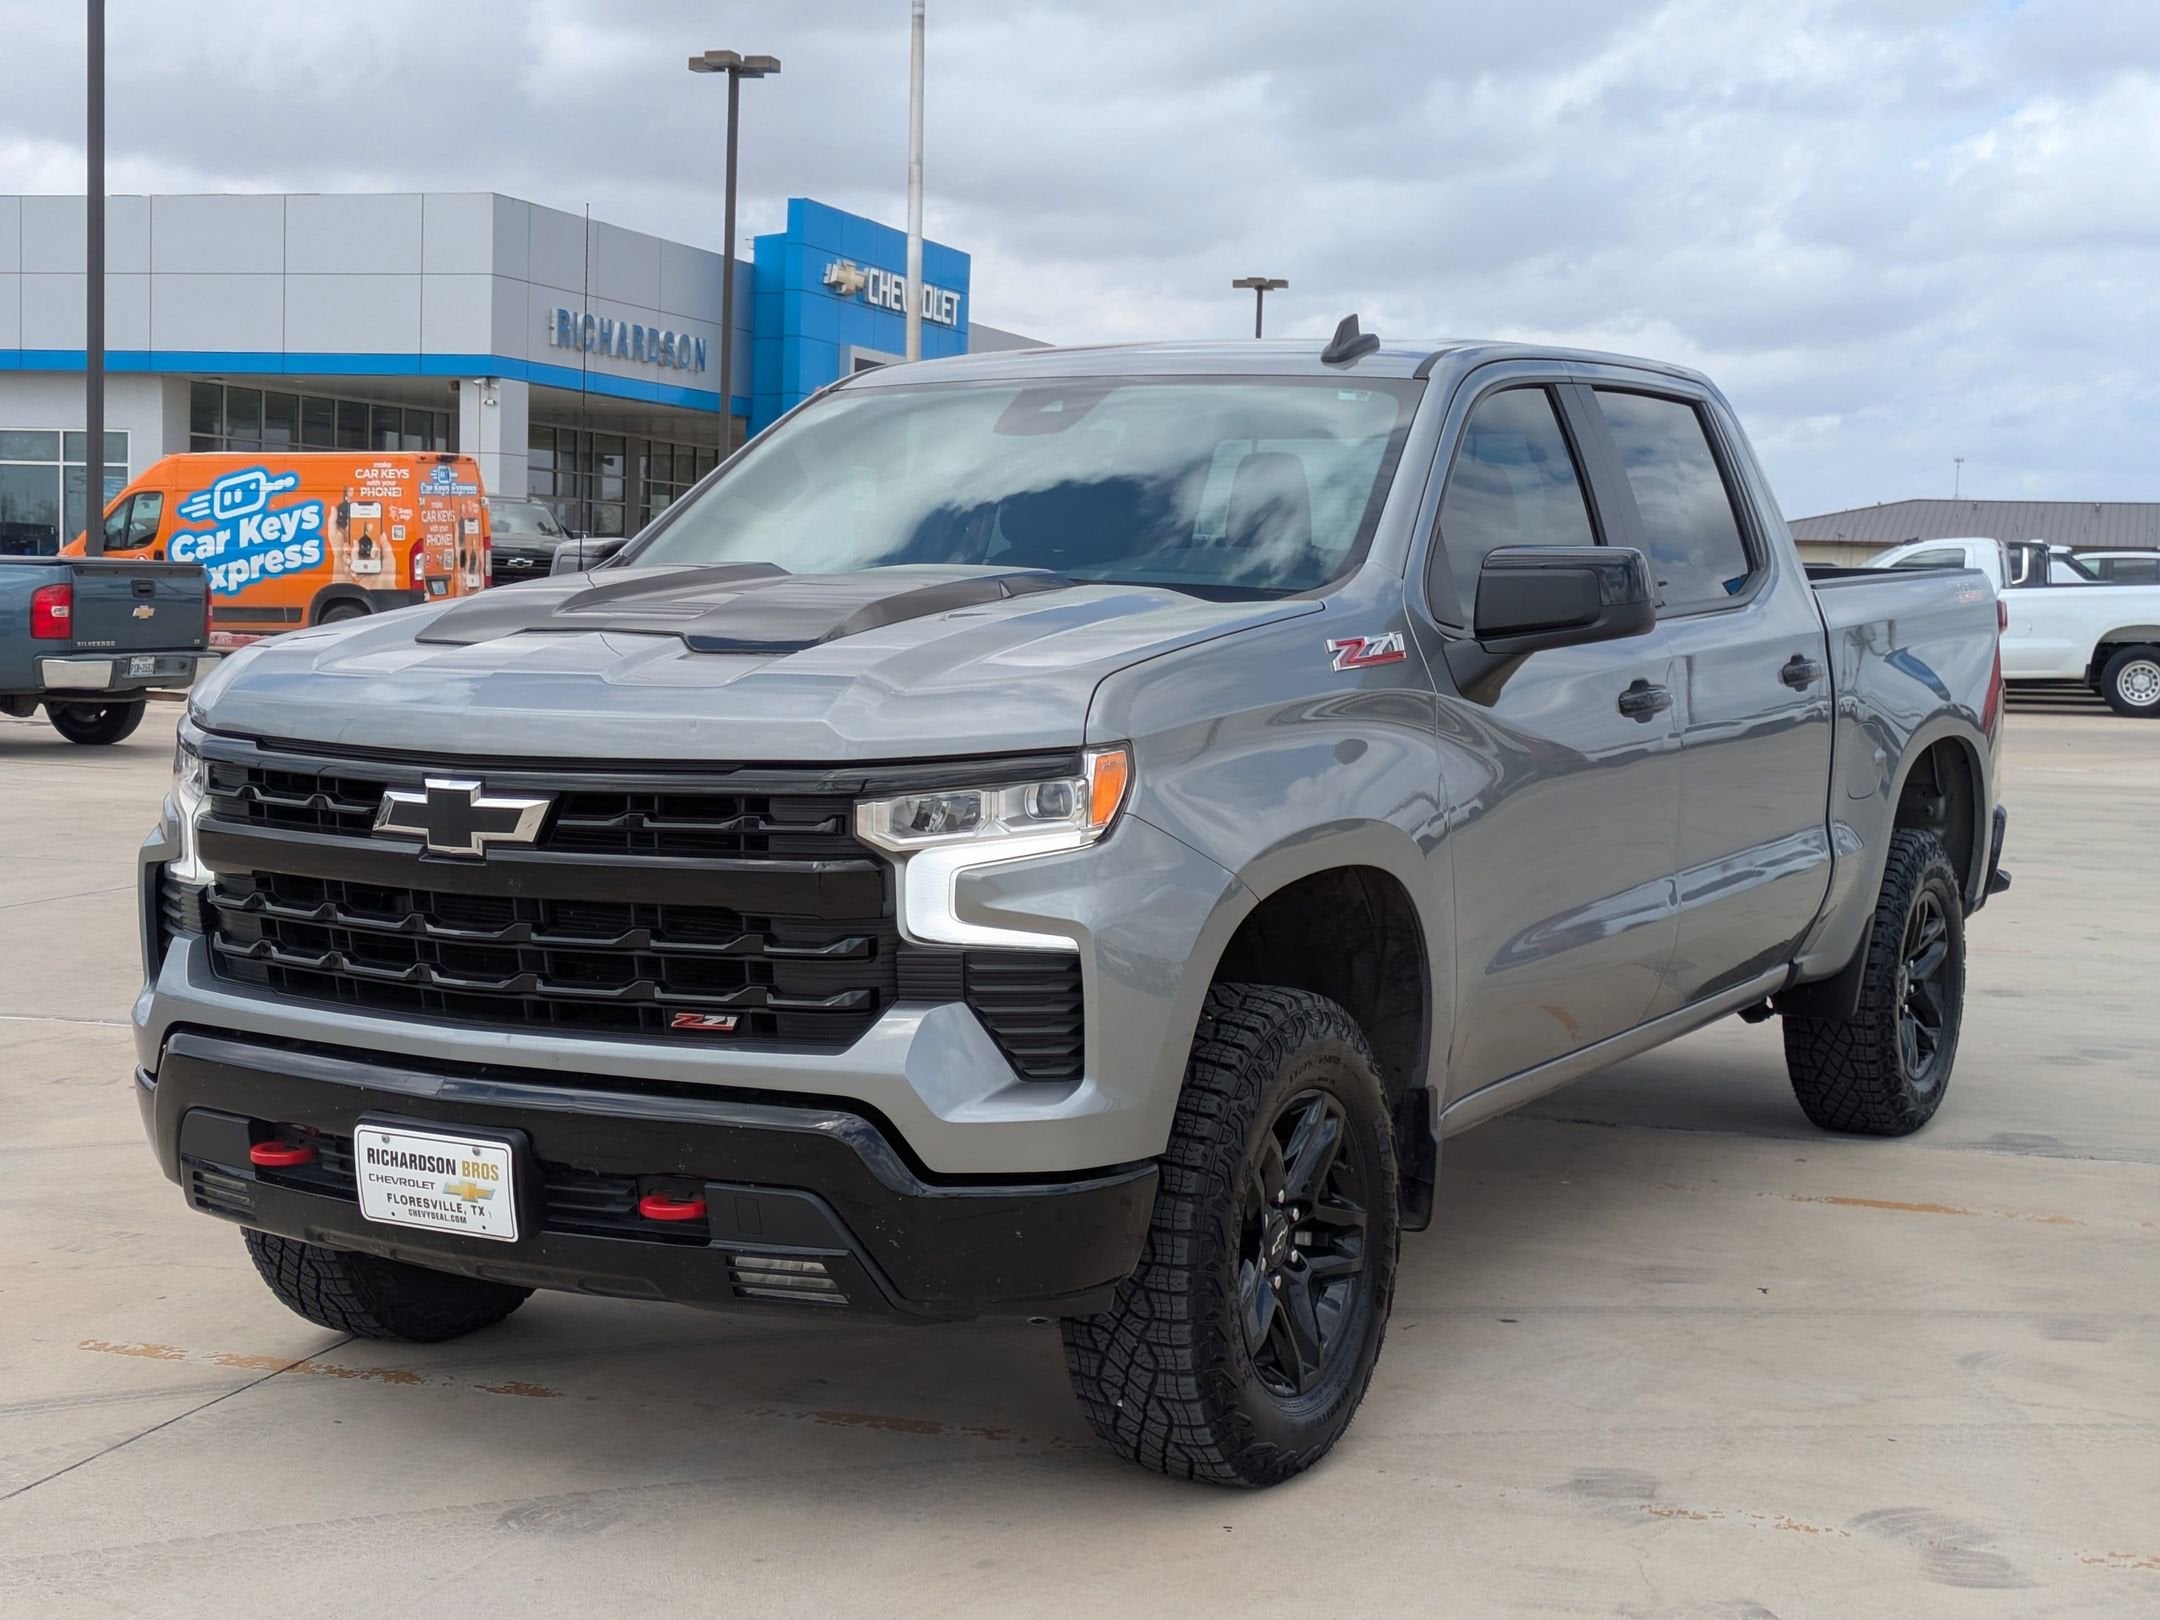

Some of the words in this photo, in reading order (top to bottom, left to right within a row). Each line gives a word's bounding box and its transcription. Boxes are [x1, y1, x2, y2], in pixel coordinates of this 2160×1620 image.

[866, 266, 960, 326] CHEVOLET
[551, 308, 706, 372] RICHARDSON
[355, 469, 379, 479] CAR
[381, 468, 410, 479] KEYS
[360, 487, 402, 497] PHONE!
[421, 510, 437, 522] CAR
[437, 510, 455, 521] KEYS
[171, 529, 231, 562] Car
[239, 504, 320, 548] Keys
[205, 539, 321, 592] xpress
[1325, 631, 1406, 672] Z71
[671, 1013, 738, 1031] Z71
[367, 1147, 456, 1176] RICHARDSON
[461, 1160, 499, 1181] BROS
[368, 1173, 435, 1190] CHEVROLET
[386, 1192, 467, 1216] FLORESVILLE,
[471, 1205, 485, 1217] TX
[408, 1209, 467, 1224] CHEVYDEAL.COM
